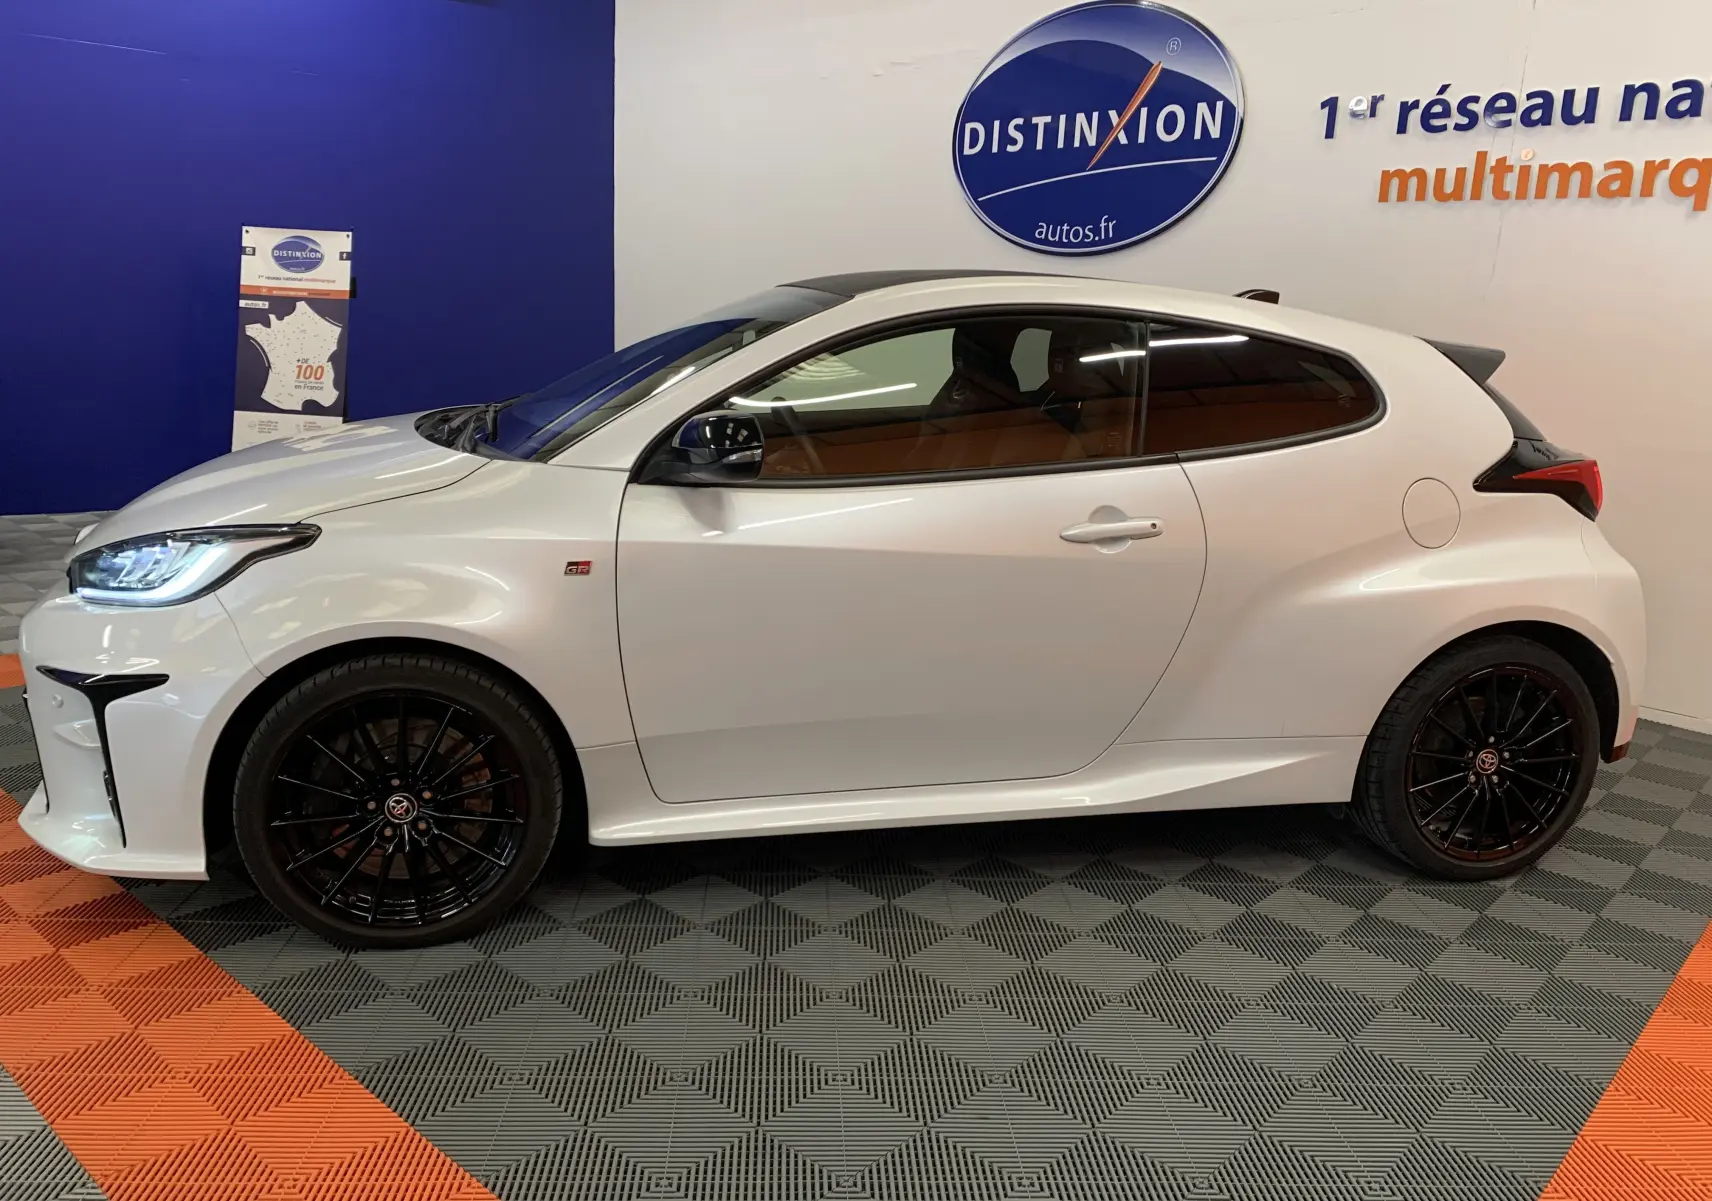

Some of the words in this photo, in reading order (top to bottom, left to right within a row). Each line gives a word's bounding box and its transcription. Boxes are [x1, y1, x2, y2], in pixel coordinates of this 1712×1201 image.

[1396, 83, 1600, 135] réseau
[1618, 78, 1712, 122] na
[963, 99, 1224, 156] DISTINXION
[1378, 149, 1712, 212] multimarq
[1034, 215, 1117, 244] autos.fr
[273, 249, 322, 259] DISTINXION
[295, 364, 325, 381] 100
[565, 564, 590, 575] GR
